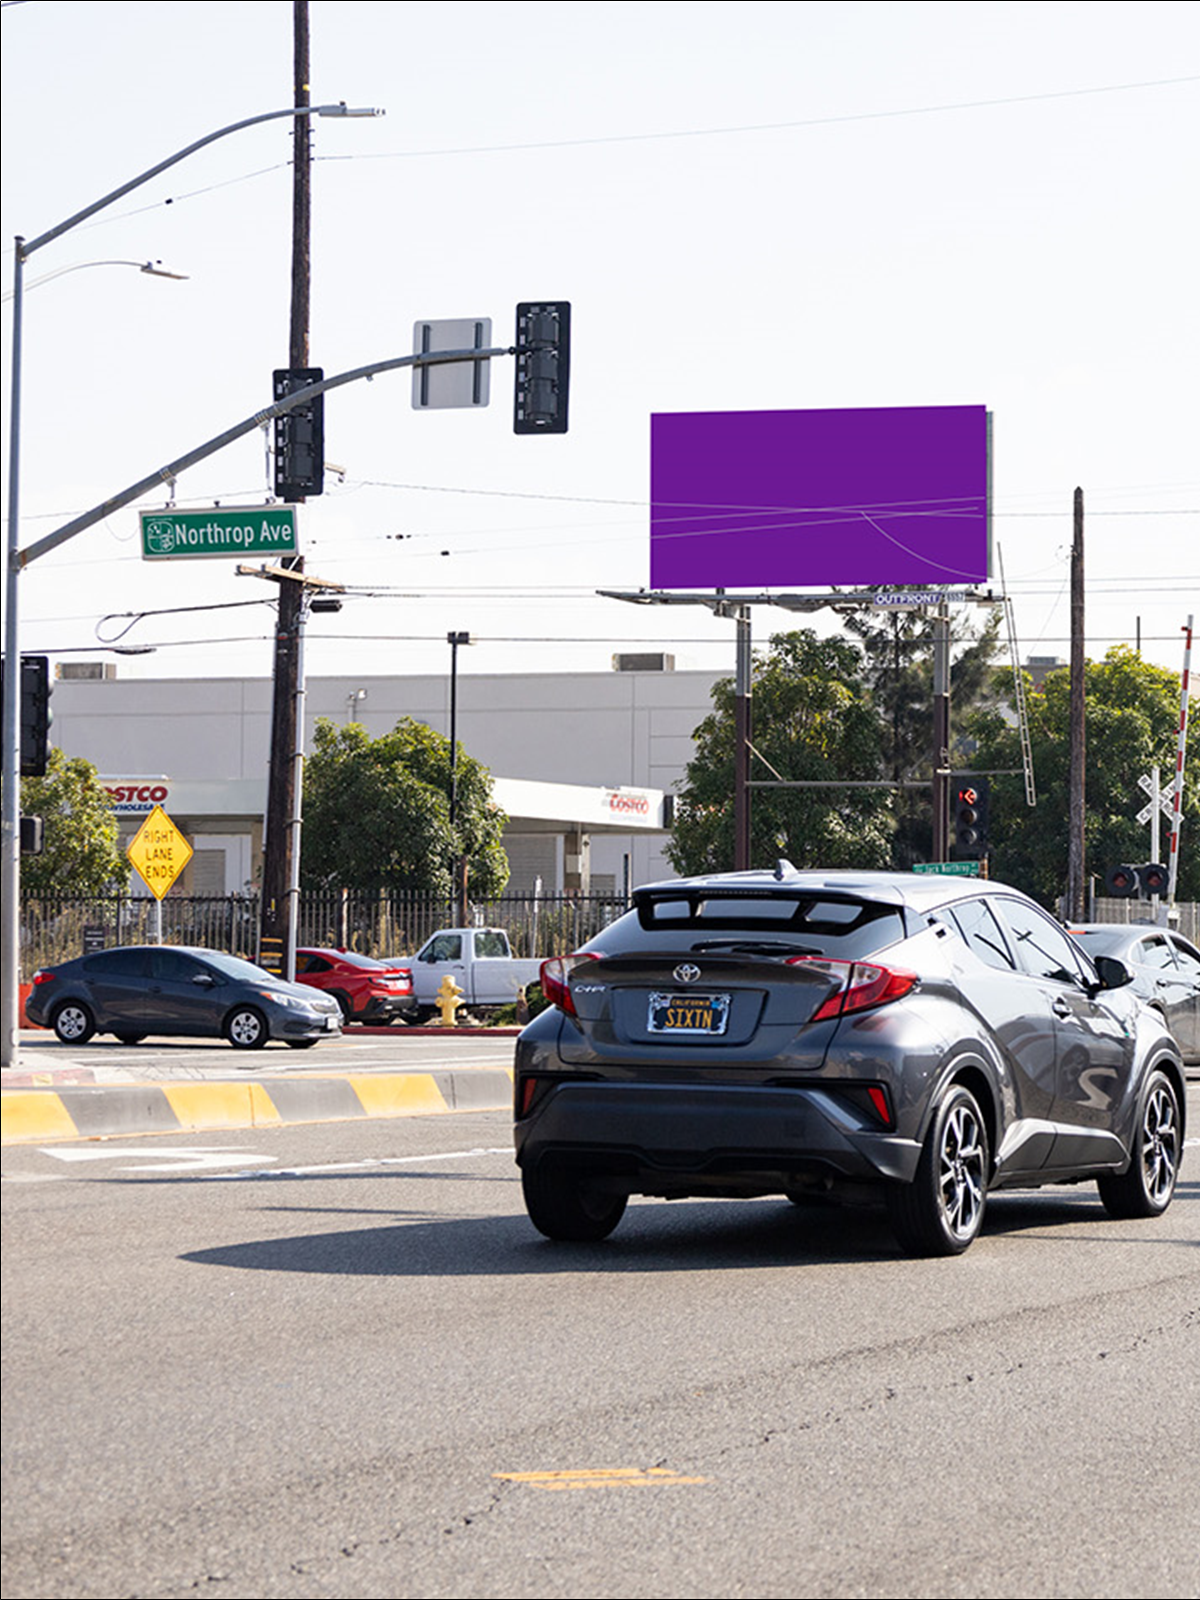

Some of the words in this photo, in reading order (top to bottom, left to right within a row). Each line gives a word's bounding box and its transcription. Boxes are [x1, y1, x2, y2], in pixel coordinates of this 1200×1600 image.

[175, 523, 254, 547] Northrop
[260, 520, 292, 542] Ave
[103, 786, 168, 802] STCO
[144, 830, 174, 843] RIGHT
[146, 848, 173, 861] LANE
[146, 865, 174, 878] ENDS
[665, 1008, 713, 1028] SIXTN
